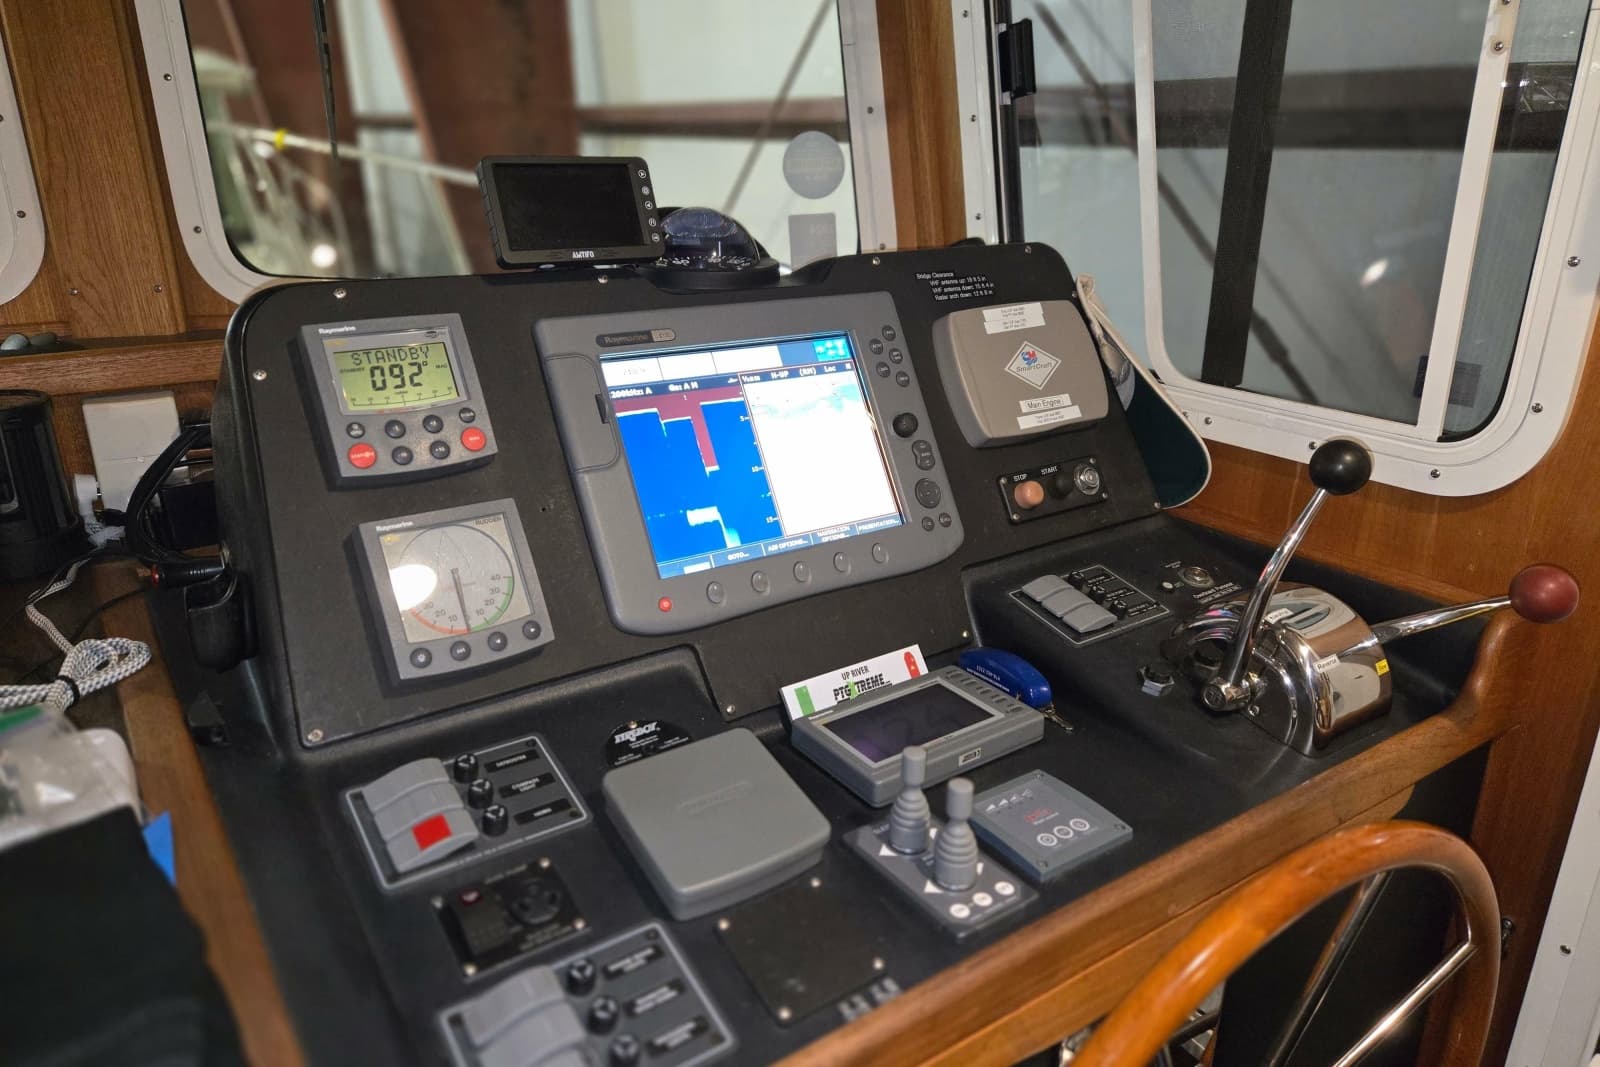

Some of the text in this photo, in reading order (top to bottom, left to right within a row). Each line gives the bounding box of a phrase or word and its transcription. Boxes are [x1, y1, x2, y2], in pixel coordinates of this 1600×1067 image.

[318, 325, 356, 335] Raymarine
[351, 346, 430, 366] STANDBY
[1016, 361, 1053, 374] SmartCraft
[1026, 398, 1062, 410] Main Engine
[1040, 465, 1059, 475] START
[1013, 473, 1028, 482] STOP
[376, 521, 413, 531] Raymarine
[490, 573, 501, 581] 40
[489, 587, 500, 595] 30
[484, 598, 495, 606] 20
[435, 608, 446, 617] 20
[475, 608, 485, 616] 10
[448, 614, 458, 623] 10
[841, 664, 870, 681] UP RIVER
